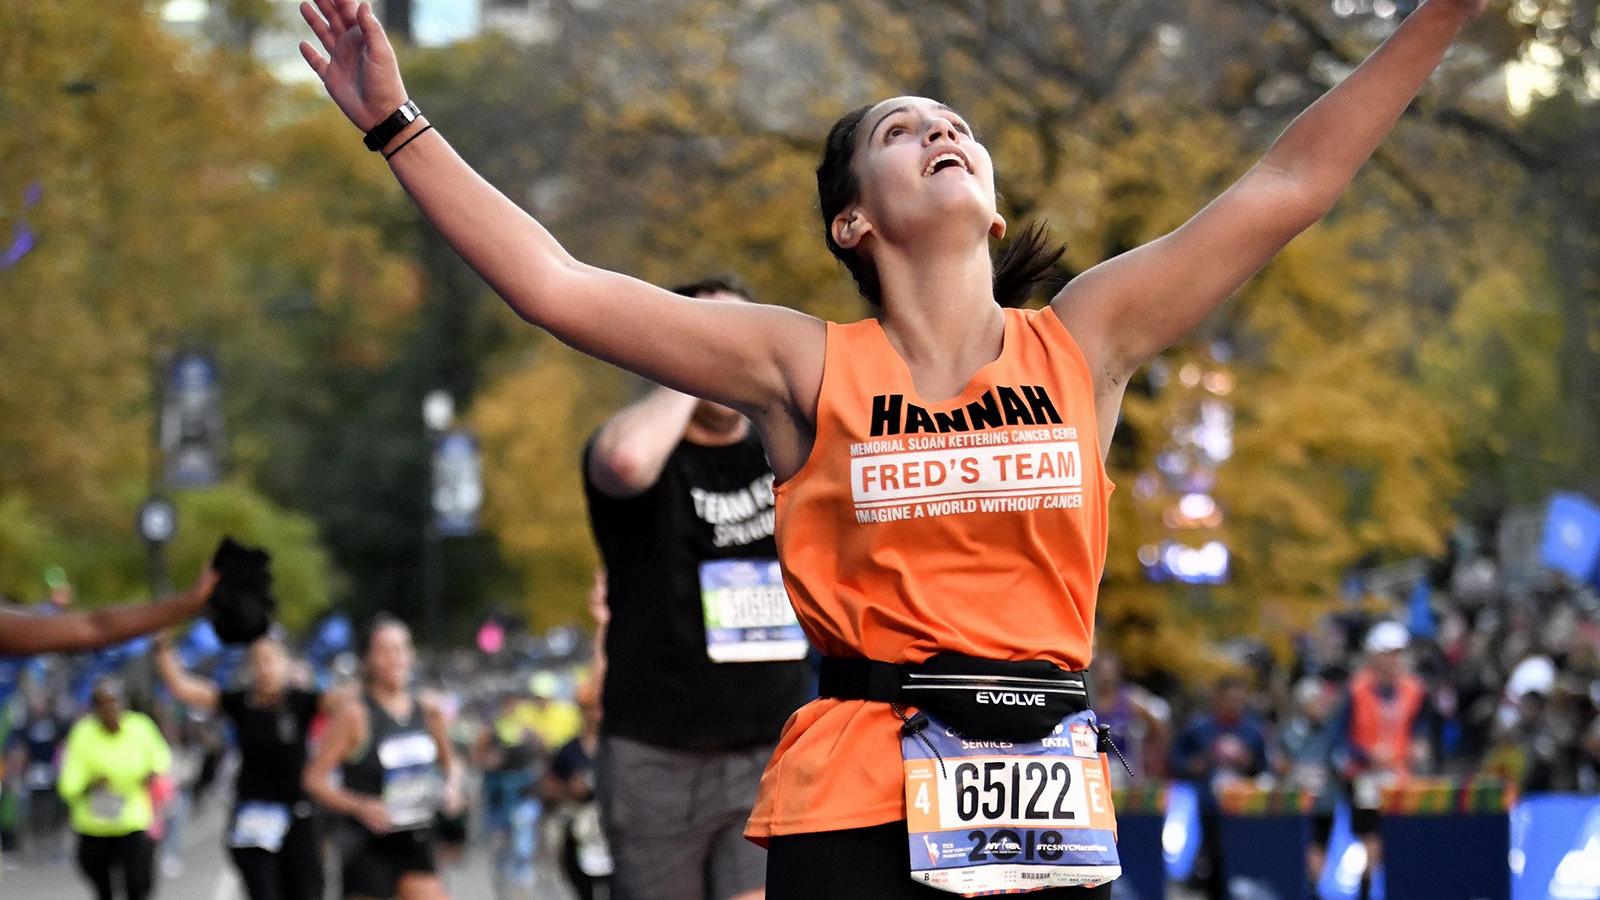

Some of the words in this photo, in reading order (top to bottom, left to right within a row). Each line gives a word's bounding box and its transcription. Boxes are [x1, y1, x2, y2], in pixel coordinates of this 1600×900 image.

[870, 385, 1064, 437] HANNAH
[850, 439, 905, 456] MEMORIAL
[908, 435, 945, 450] SLOAN
[948, 430, 1009, 448] KETTERING
[1012, 428, 1051, 443] CANCER
[861, 457, 981, 493] FRED'S
[992, 451, 1076, 482] TEAM
[856, 505, 911, 524] IMAGINE
[914, 504, 925, 518] A
[927, 499, 977, 517] WORLD
[981, 496, 1041, 513] WITHOUT
[1043, 494, 1082, 509] CANCER
[976, 691, 1046, 706] EVOLVE
[1041, 737, 1070, 748] TATA
[914, 782, 931, 815] 4
[955, 761, 1075, 822] 65122
[1089, 781, 1105, 813] E
[968, 830, 1064, 862] 2018
[1036, 843, 1108, 852] #TCSNYCMarathon
